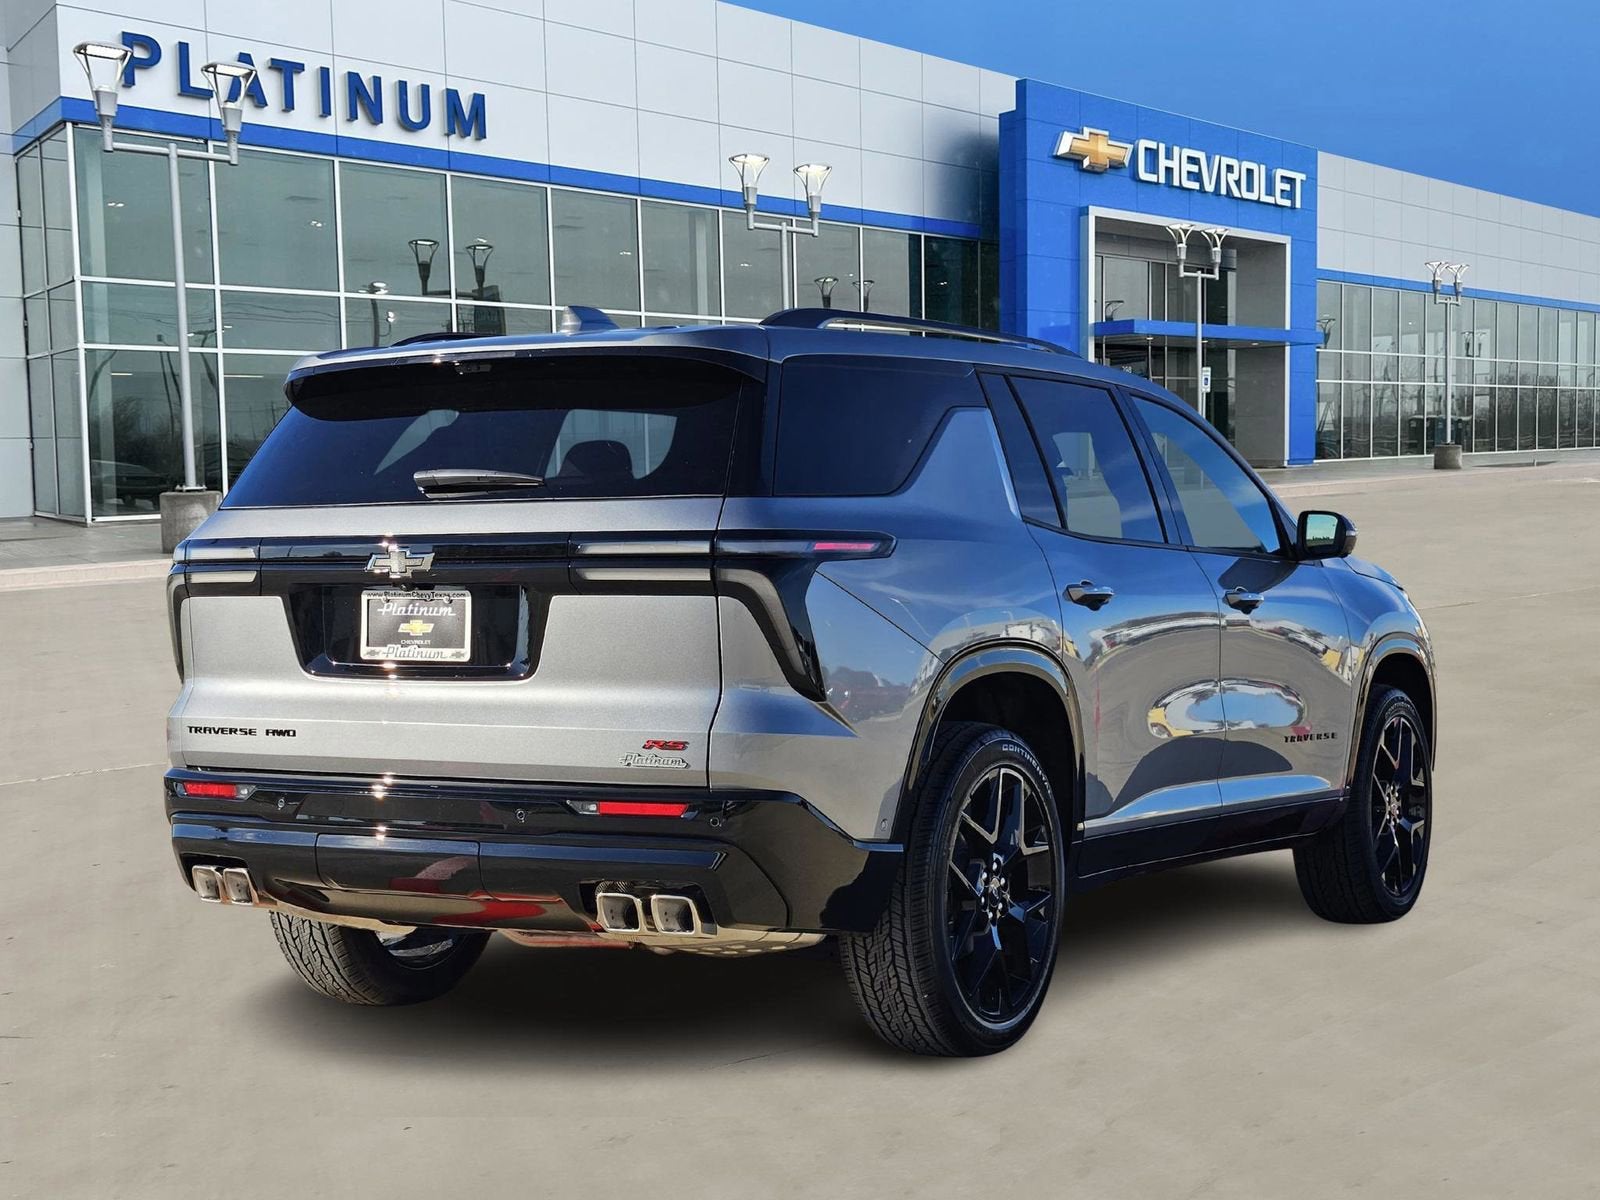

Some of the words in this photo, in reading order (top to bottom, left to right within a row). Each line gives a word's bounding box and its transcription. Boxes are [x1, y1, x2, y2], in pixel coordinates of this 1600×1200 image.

[121, 31, 487, 140] PLATINUM
[1135, 138, 1307, 208] CHEVROLET
[377, 602, 457, 616] Platinum
[383, 645, 447, 659] Platinum
[187, 725, 257, 737] TRAVERSE
[265, 728, 297, 738] AWD
[1283, 731, 1338, 743] TRAVERSE
[642, 740, 689, 750] RS
[619, 751, 691, 769] Platinum
